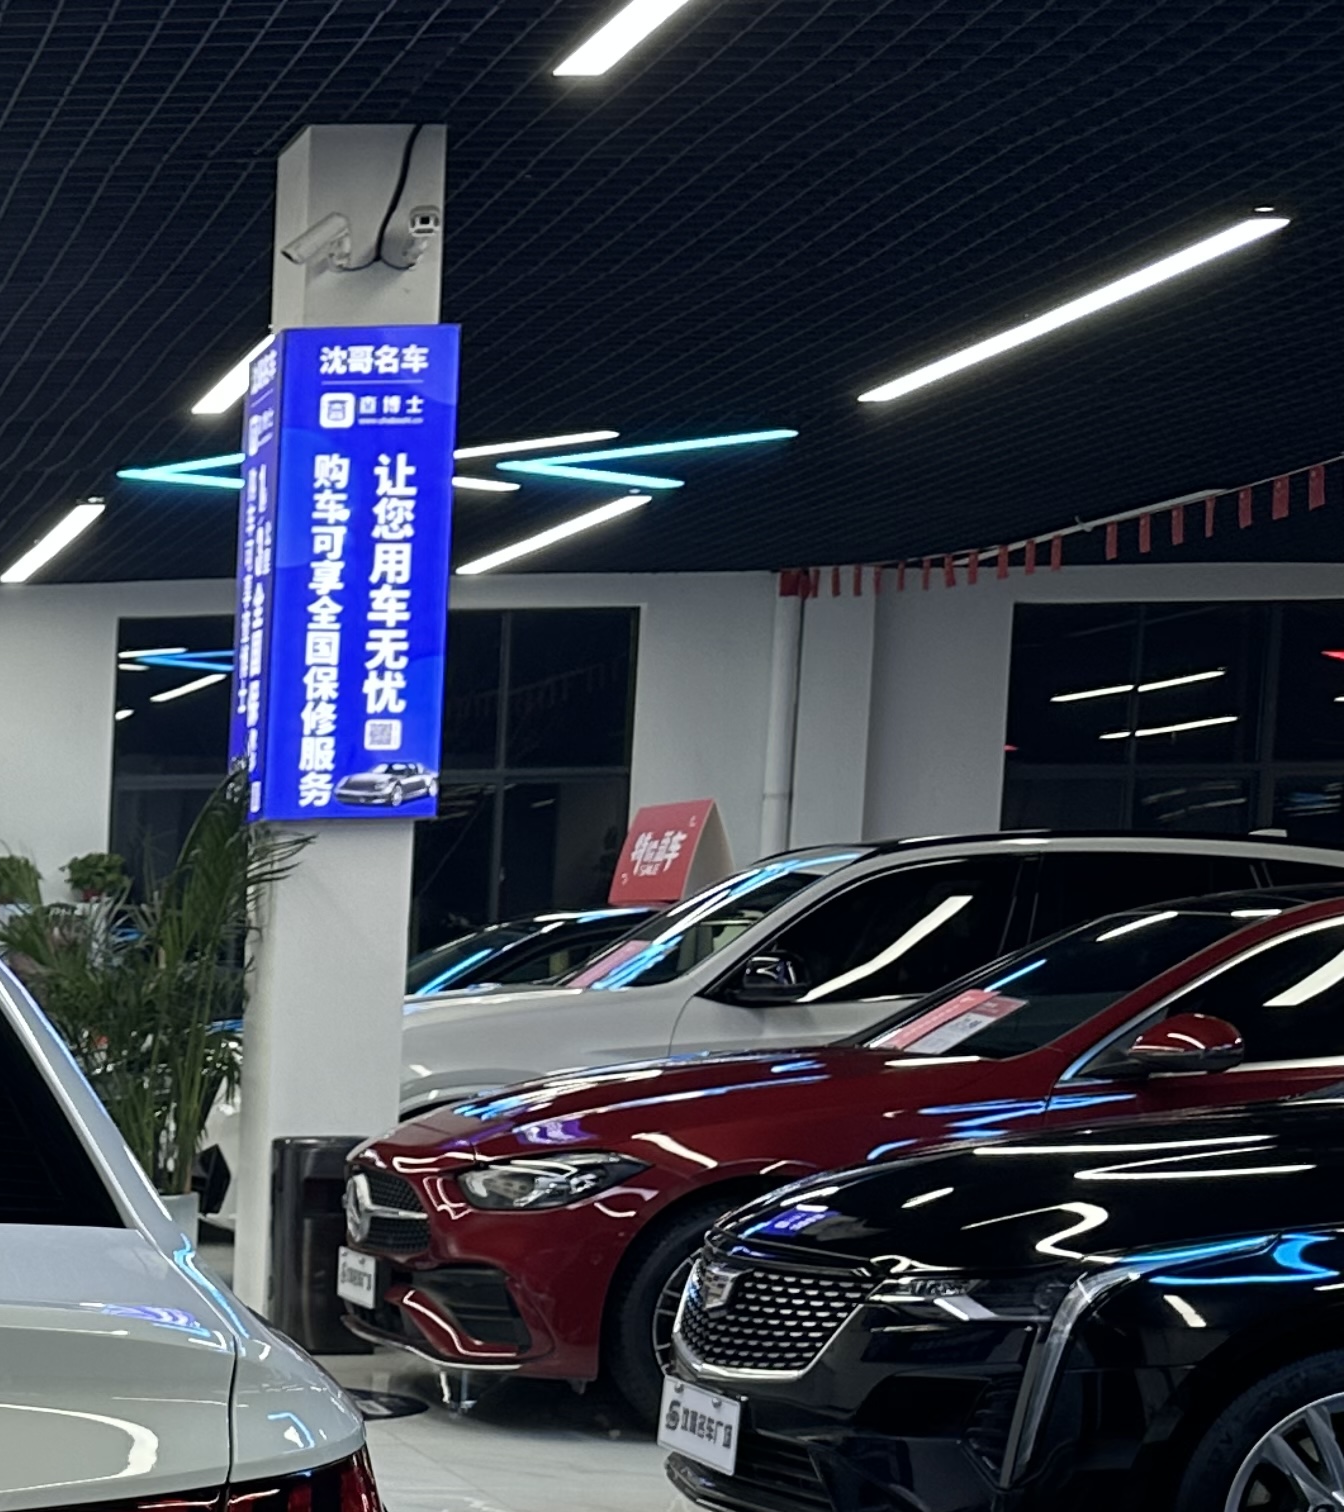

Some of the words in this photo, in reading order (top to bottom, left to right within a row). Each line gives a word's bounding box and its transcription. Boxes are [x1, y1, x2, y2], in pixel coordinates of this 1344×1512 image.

[319, 344, 430, 374] 沈哥名车
[298, 453, 351, 808] 购车可享全国保修服务
[362, 453, 418, 714] 让您用车无忧
